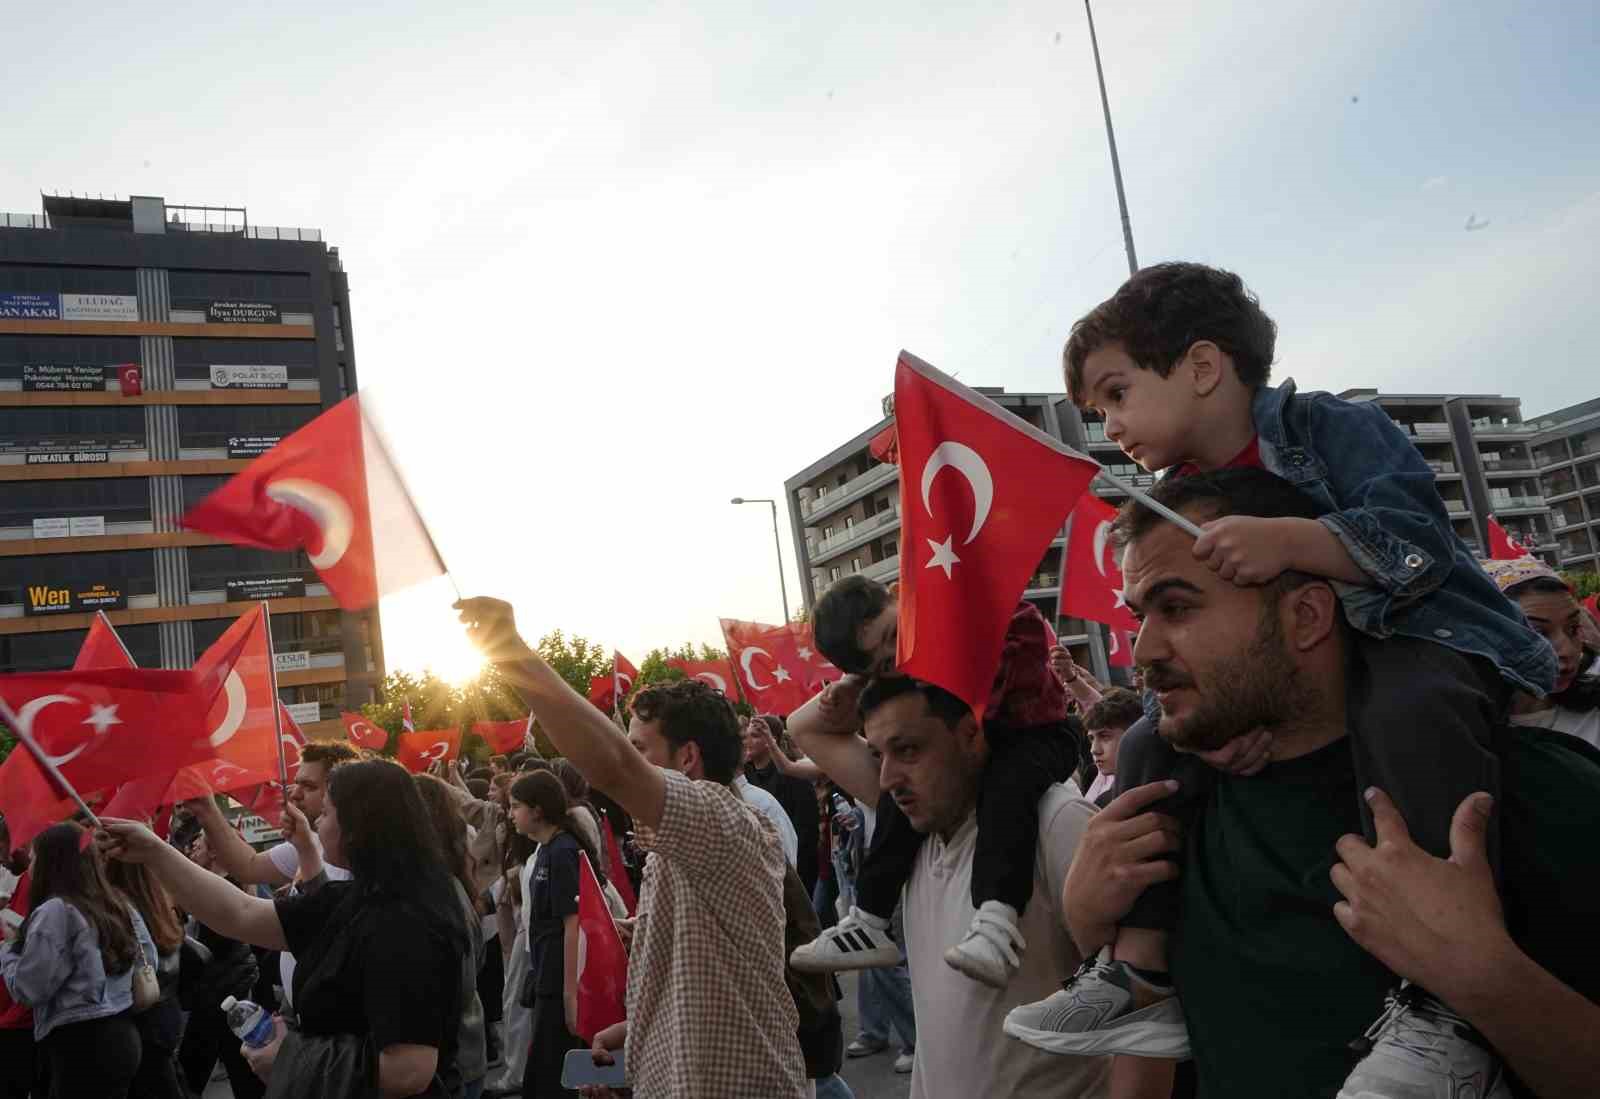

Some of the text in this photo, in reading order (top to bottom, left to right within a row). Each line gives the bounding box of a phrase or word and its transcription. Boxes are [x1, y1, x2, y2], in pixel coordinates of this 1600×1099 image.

[78, 295, 124, 306] ULUDAĞ
[22, 308, 58, 318] AKAR
[232, 308, 277, 318] DURGUN
[28, 451, 107, 464] AVUKATLIK BÜROSU
[29, 585, 71, 606] Wen
